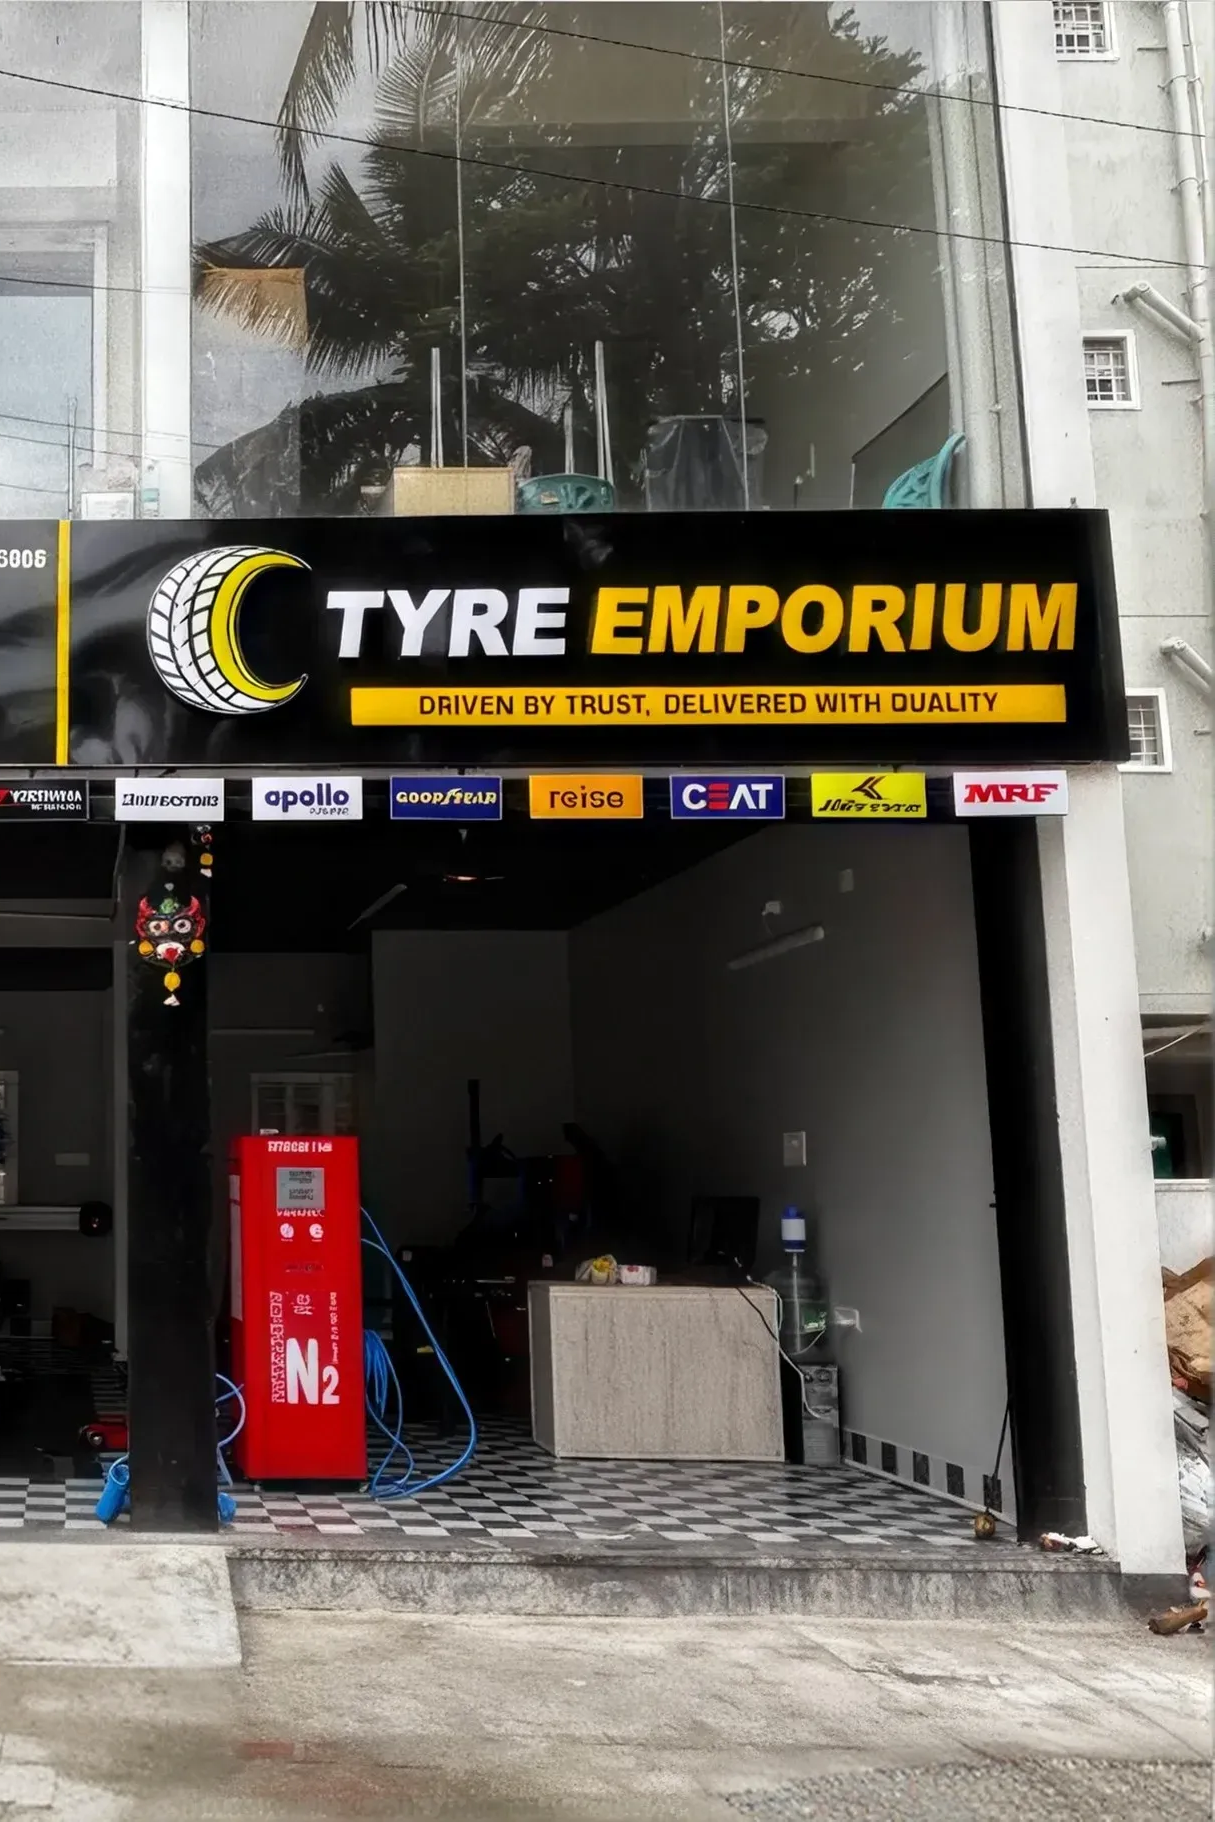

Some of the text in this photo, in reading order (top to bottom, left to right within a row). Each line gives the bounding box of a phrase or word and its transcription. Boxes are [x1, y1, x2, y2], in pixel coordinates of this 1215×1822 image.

[327, 584, 1076, 657] TYRE EMPORIUM
[420, 695, 513, 715] DRIVEN
[525, 695, 555, 715] BY
[566, 694, 650, 716] TRUST,
[665, 693, 807, 714] DELIVERED
[816, 693, 881, 713] WITH
[265, 783, 350, 812] apollo
[549, 785, 624, 809] reise
[682, 784, 773, 809] CEAT
[964, 783, 1059, 803] MRF
[286, 1338, 340, 1404] N2
